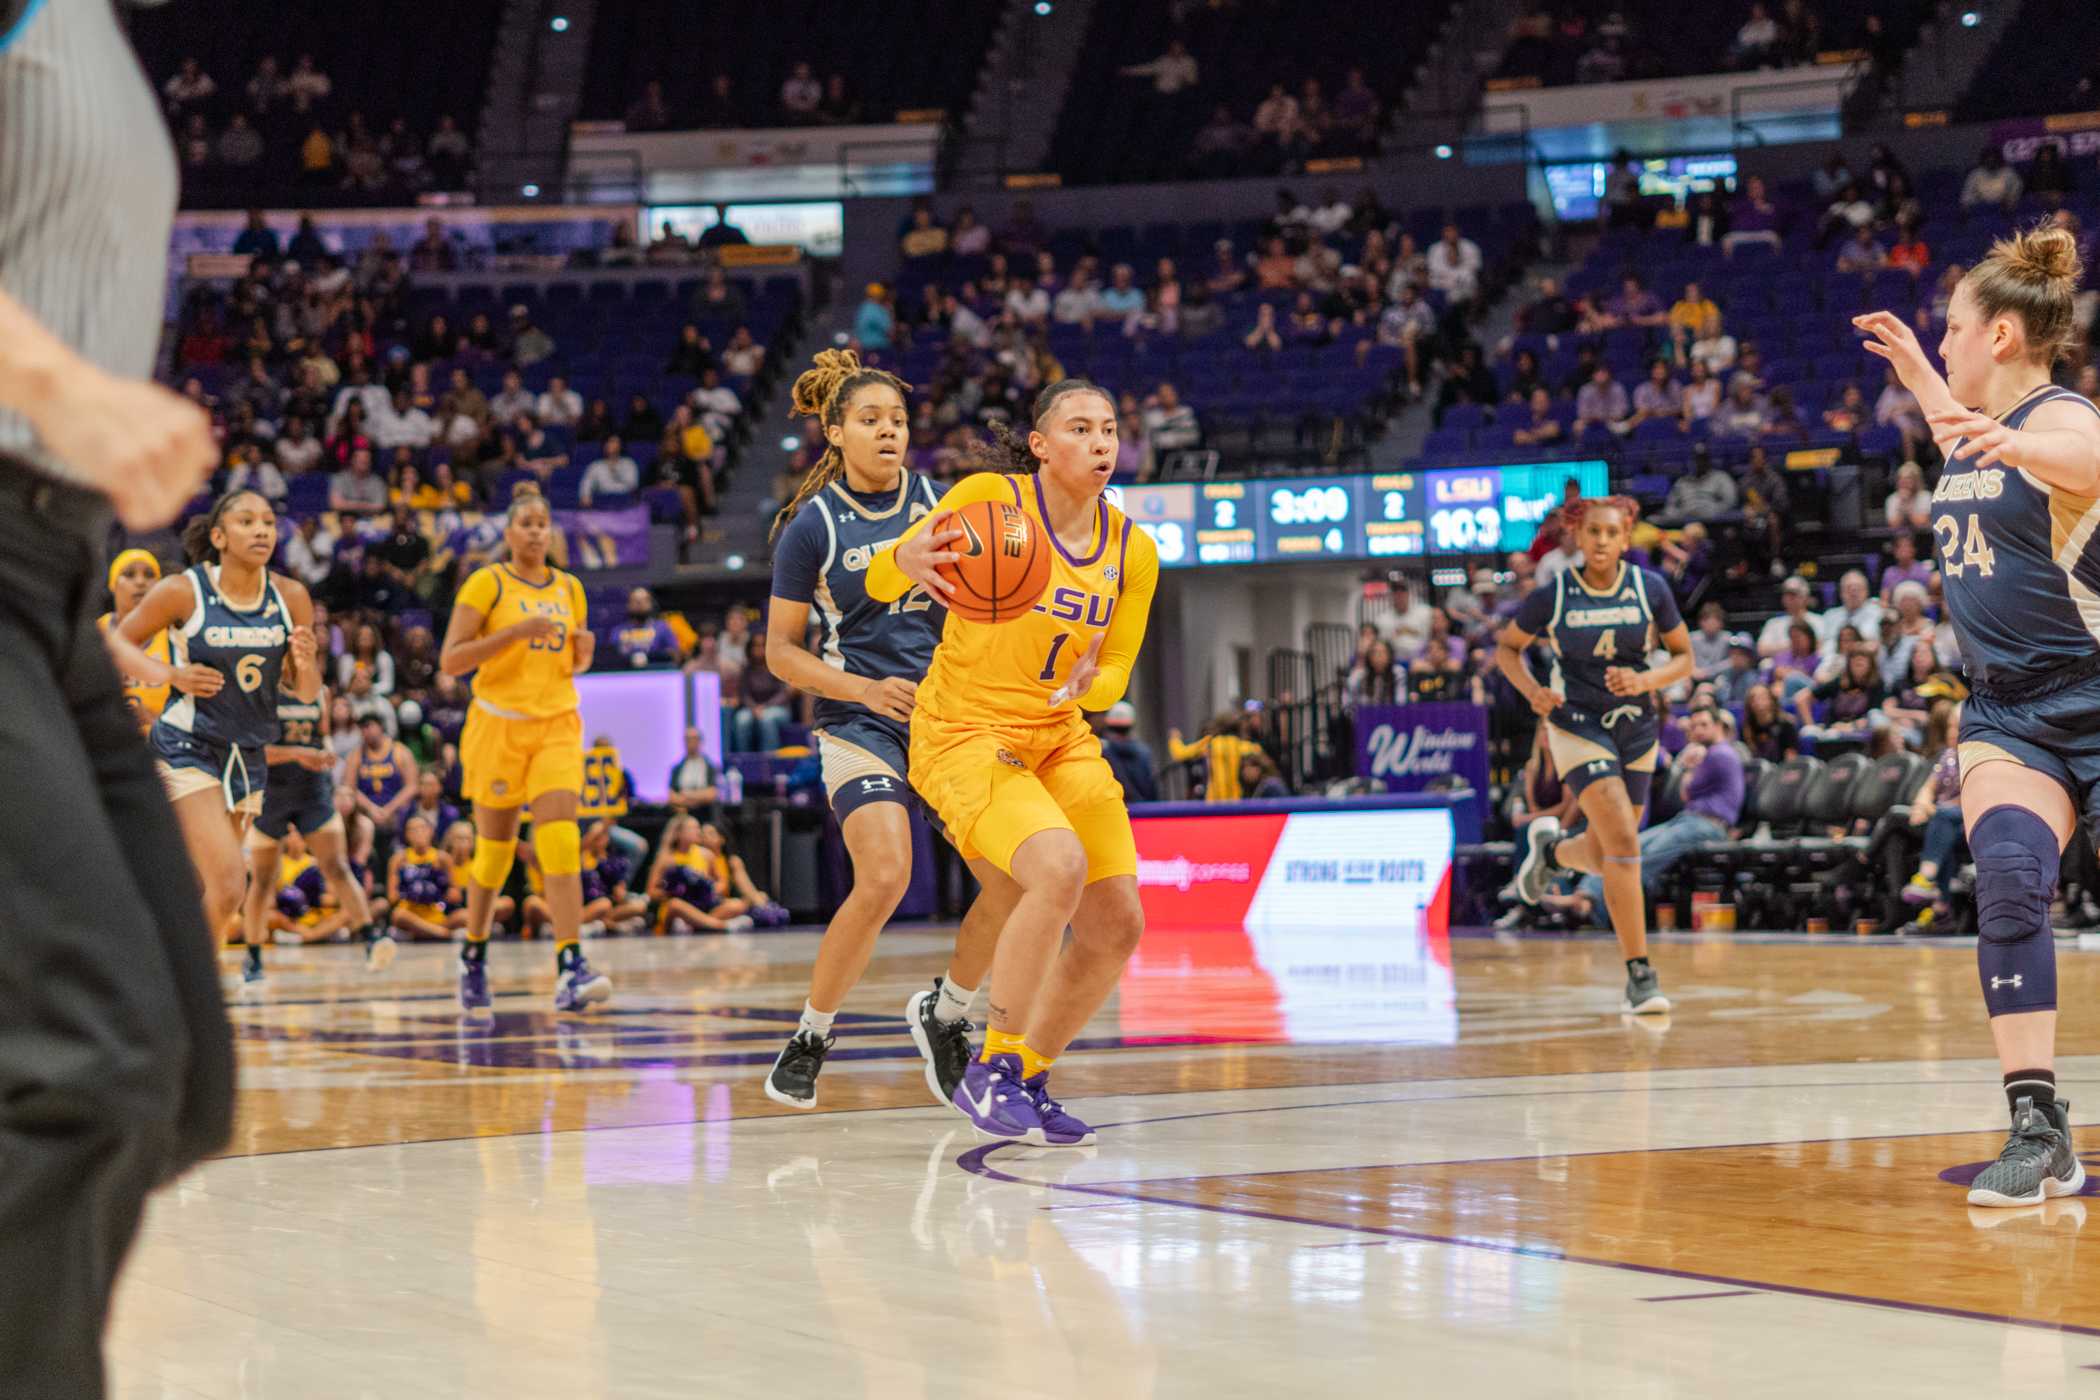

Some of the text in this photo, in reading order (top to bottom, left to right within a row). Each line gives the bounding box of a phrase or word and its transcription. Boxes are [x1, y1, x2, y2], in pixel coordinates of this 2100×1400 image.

[1435, 477, 1493, 503] LSU
[1930, 468, 2006, 502] UEENS
[1214, 499, 1236, 528] 2
[1383, 491, 1405, 520] 2
[1001, 503, 1024, 559] ELITE
[1324, 527, 1344, 551] 4
[1430, 507, 1502, 549] 103
[1933, 513, 1996, 578] 24
[1038, 632, 1070, 682] 1
[1592, 629, 1617, 661] 4
[236, 653, 267, 694] 6
